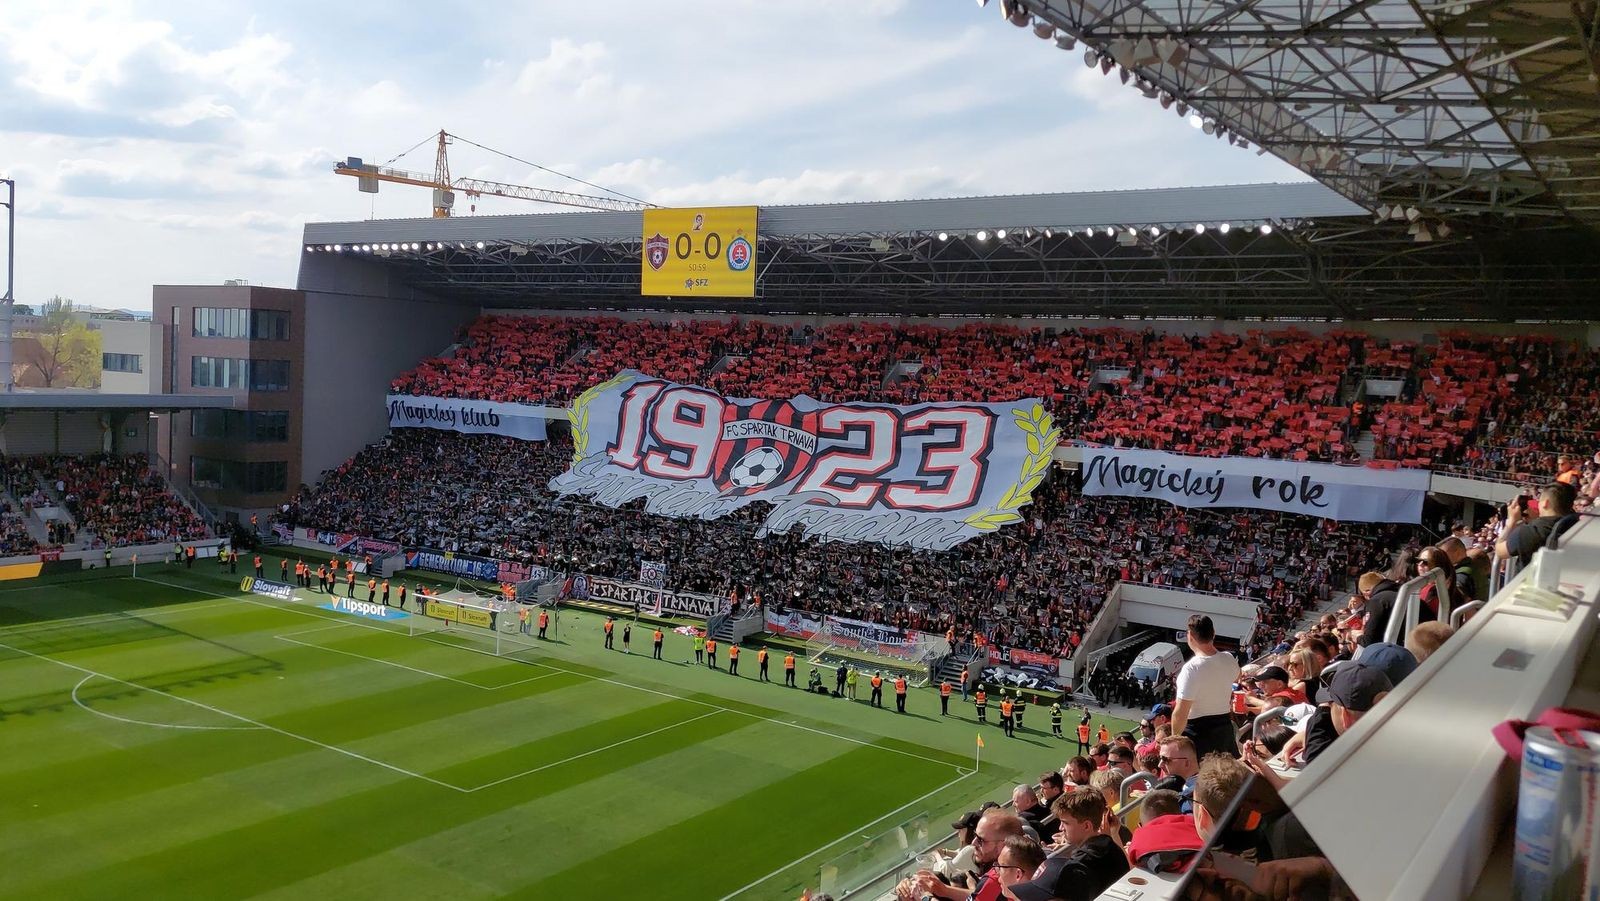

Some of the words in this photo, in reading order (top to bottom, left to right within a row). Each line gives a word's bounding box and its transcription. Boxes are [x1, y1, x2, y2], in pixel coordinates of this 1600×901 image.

[695, 278, 709, 287] SFZ
[460, 406, 501, 428] klub
[726, 424, 739, 438] FC
[740, 422, 778, 437] SPARTAK
[779, 427, 815, 453] TRNAVA
[1082, 454, 1225, 504] Magický
[1252, 475, 1329, 509] rok
[253, 579, 291, 596] Slovnaft
[341, 597, 387, 617] Tipsport
